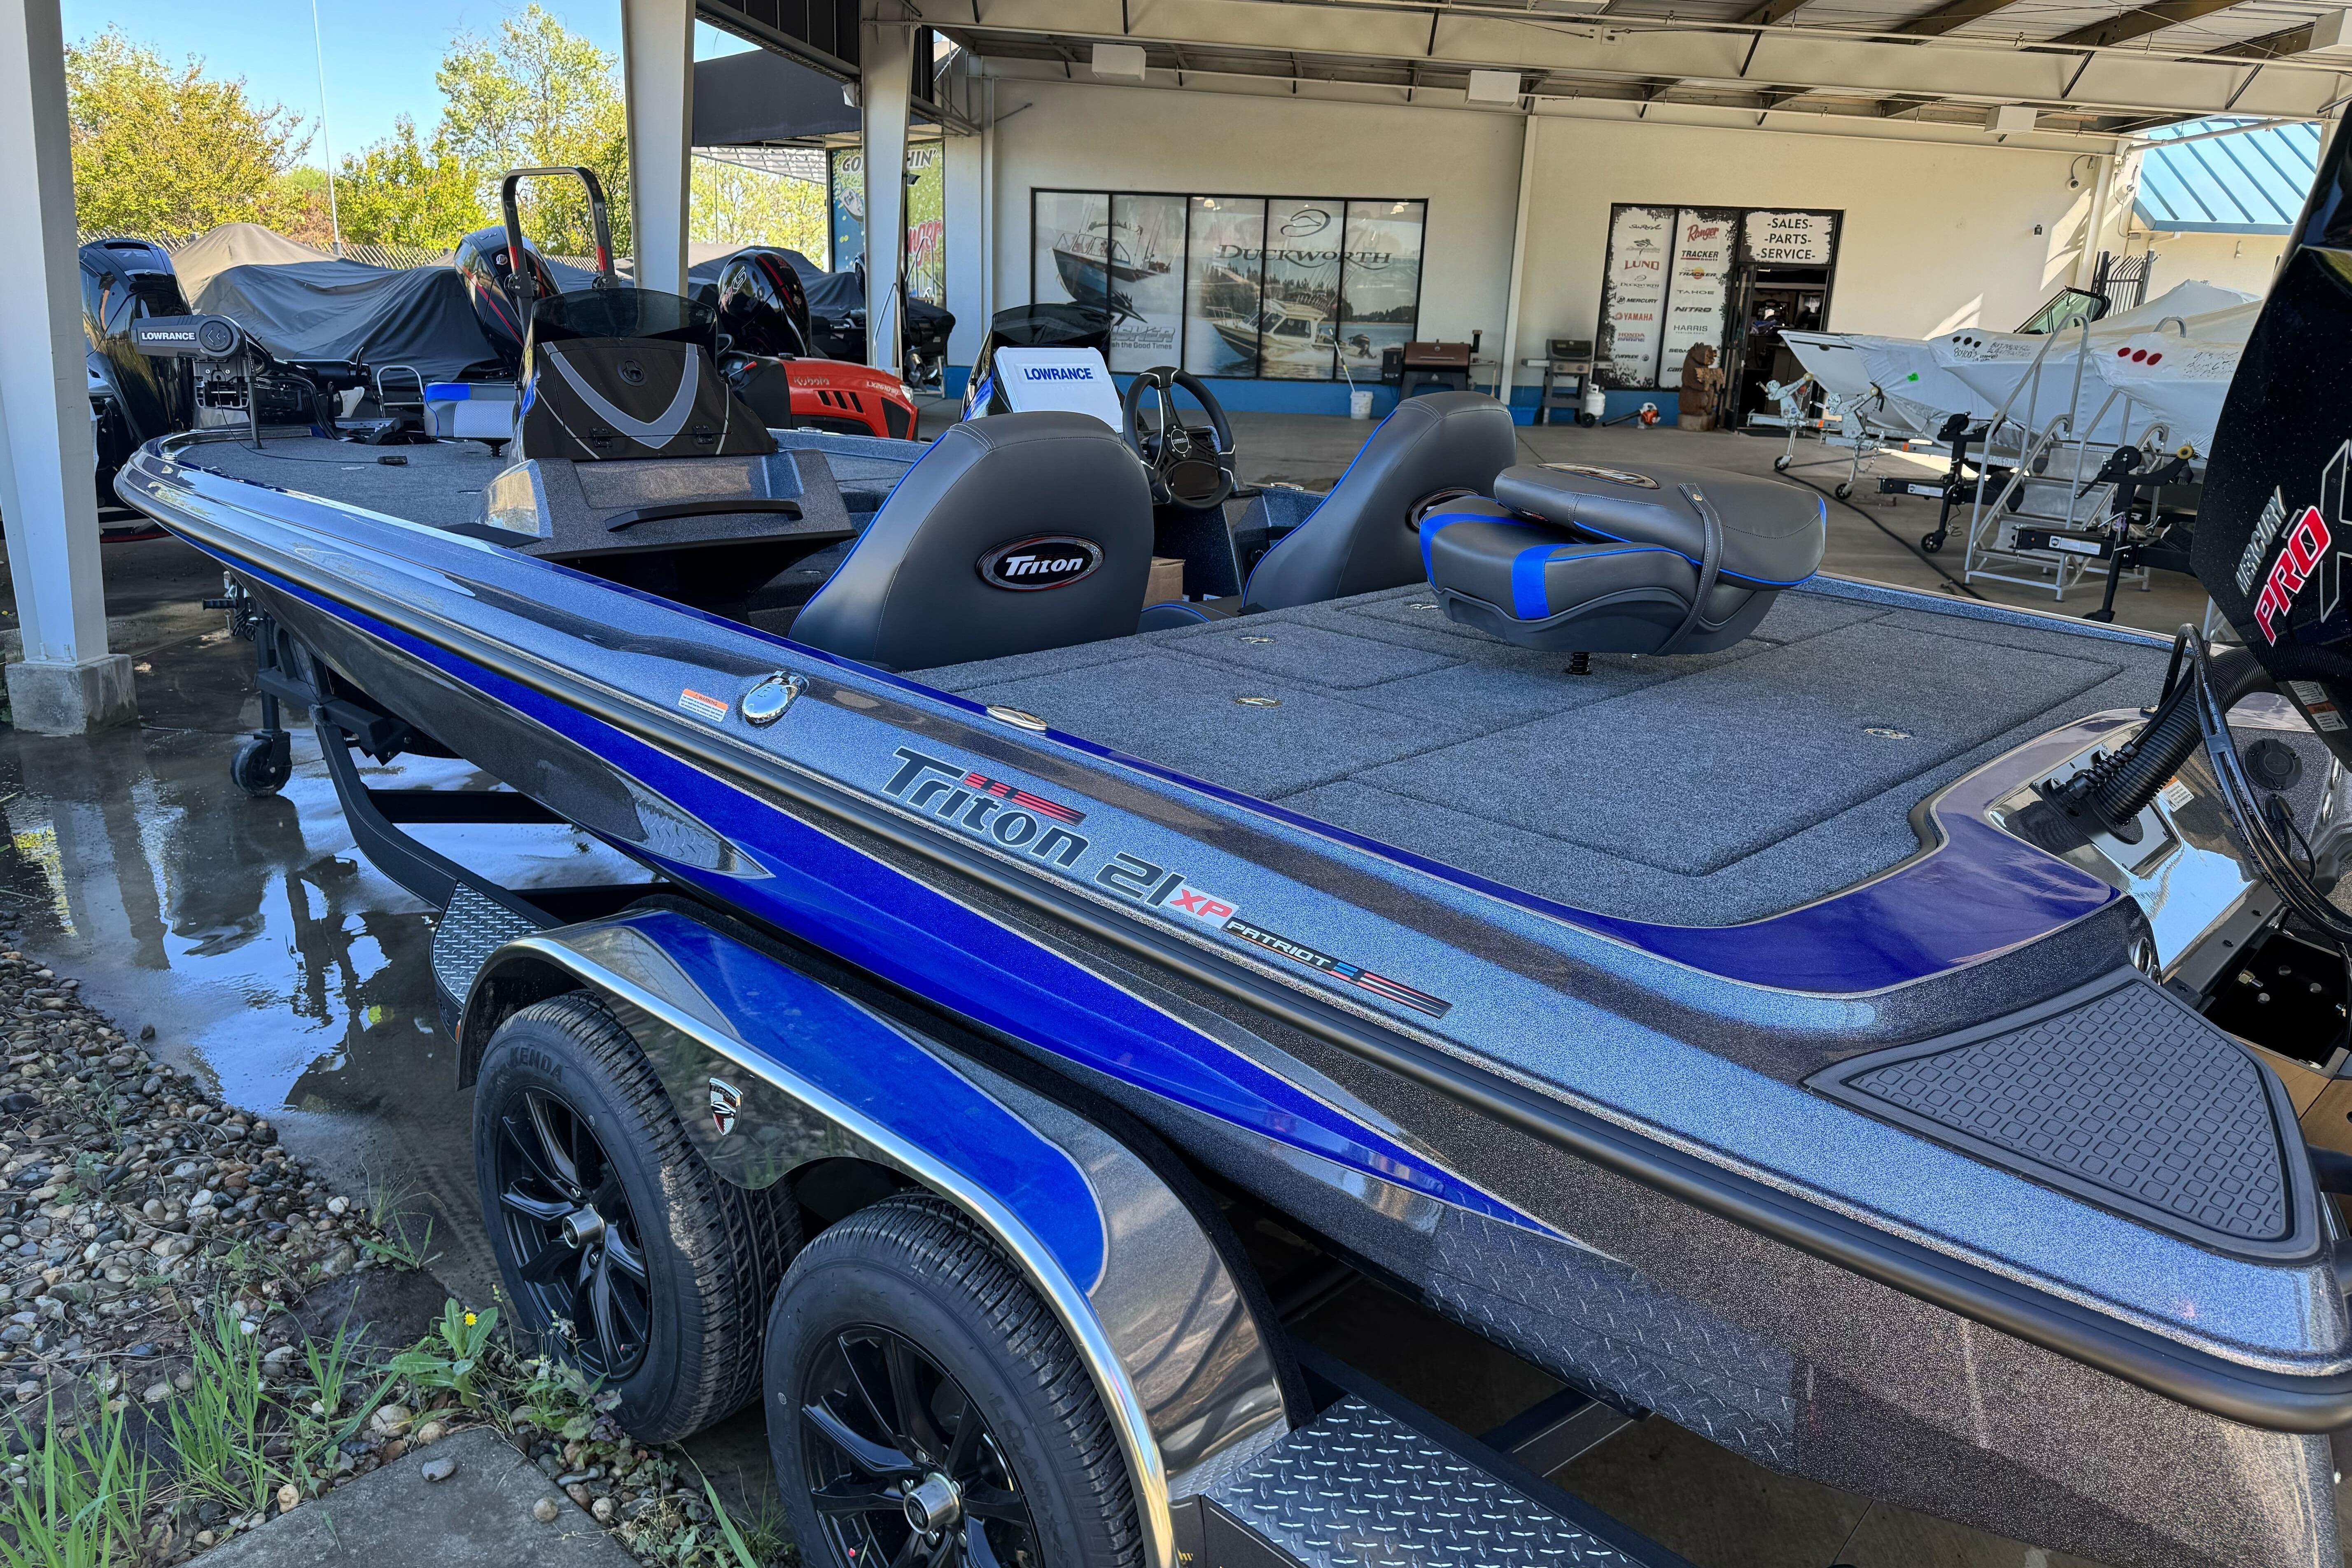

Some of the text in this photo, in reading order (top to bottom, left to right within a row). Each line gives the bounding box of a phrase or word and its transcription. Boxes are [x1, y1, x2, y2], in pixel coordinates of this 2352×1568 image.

[907, 148, 937, 168] HIN'
[1767, 218, 1813, 229] -SALES-
[1687, 224, 1719, 242] Ranger
[1764, 233, 1811, 244] -PARTS-
[1756, 248, 1815, 259] -SERVICE-
[1624, 260, 1660, 271] LUND
[1624, 313, 1653, 321] YAMAHA
[141, 332, 196, 341] LOWRANCE
[1112, 325, 1176, 343] ISHER
[794, 376, 830, 386] Kubota
[1024, 368, 1093, 380] LOWRANCE
[2235, 485, 2289, 597] MERCURY
[1005, 555, 1083, 576] Triton
[2254, 505, 2331, 647] PRO
[881, 745, 1090, 870] Triton
[1227, 920, 1332, 967] PATRIOT
[509, 1046, 563, 1083] KENDA
